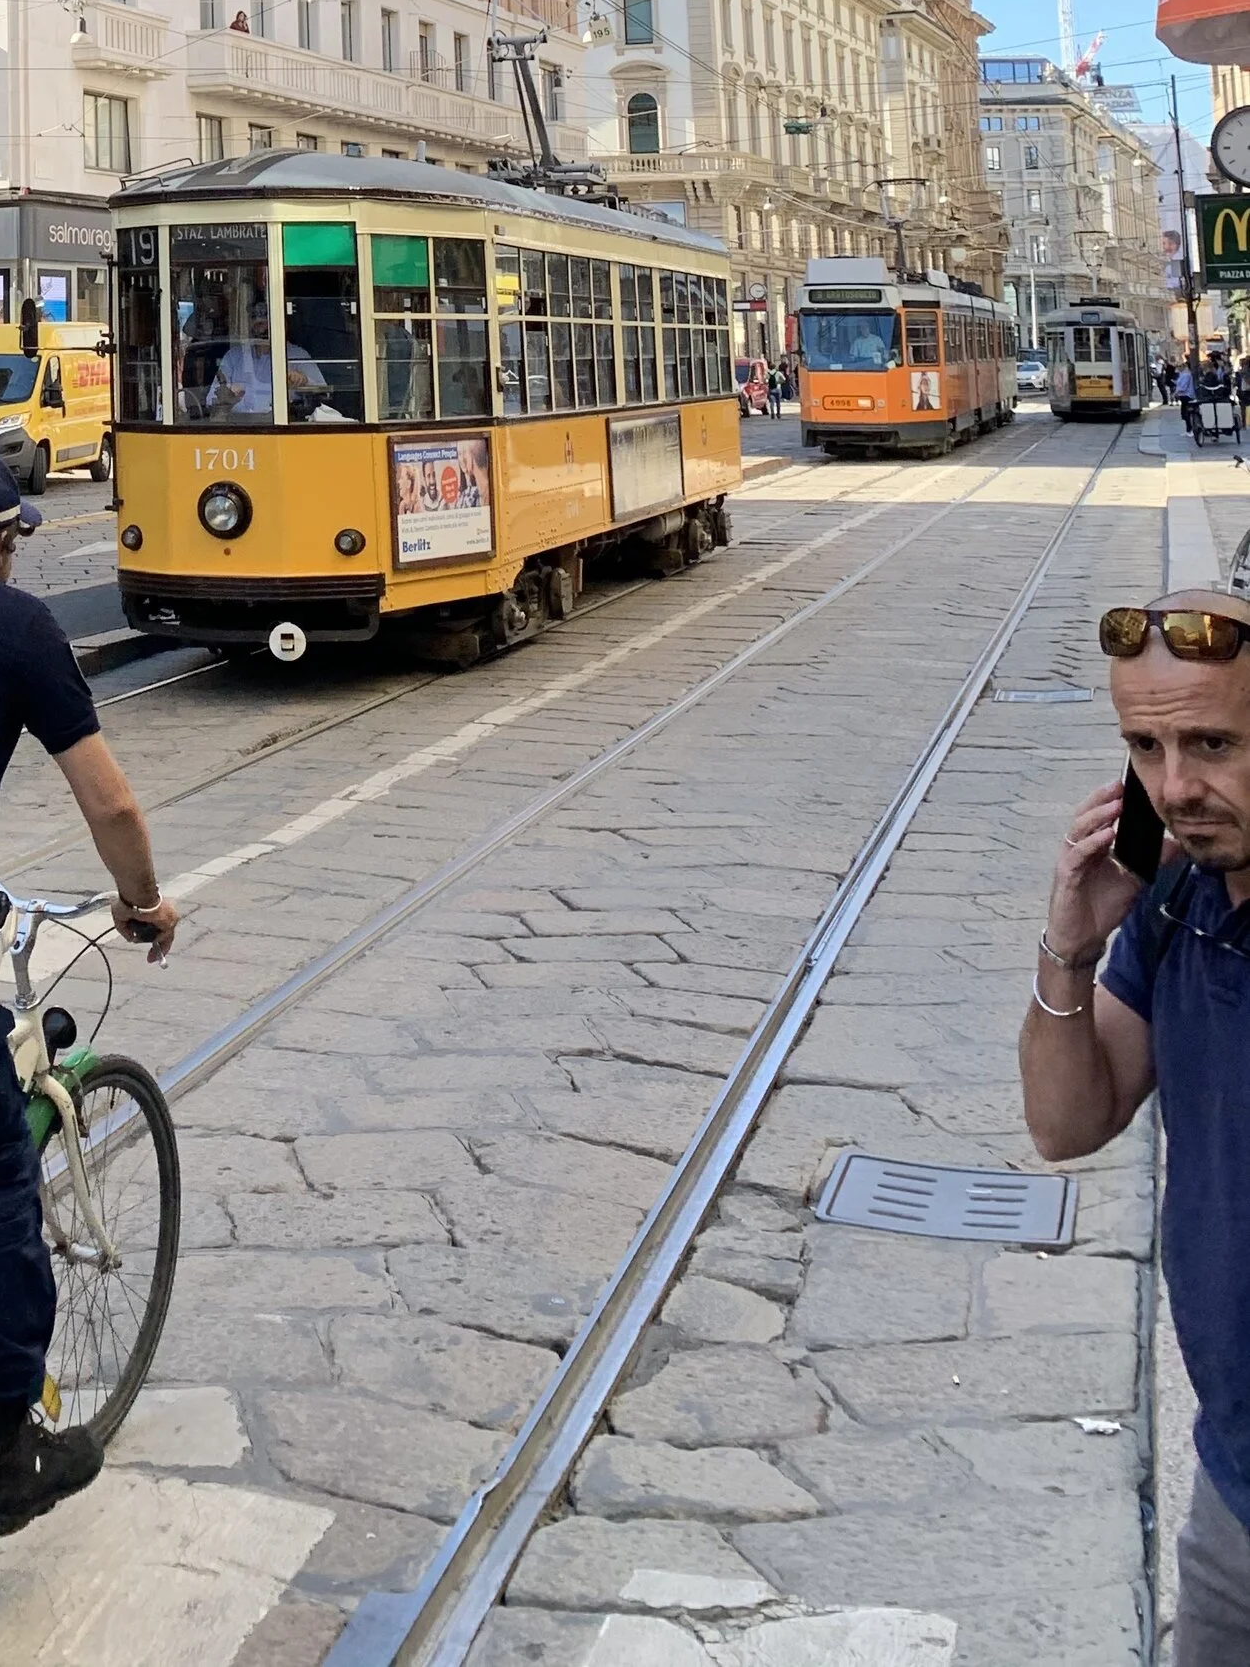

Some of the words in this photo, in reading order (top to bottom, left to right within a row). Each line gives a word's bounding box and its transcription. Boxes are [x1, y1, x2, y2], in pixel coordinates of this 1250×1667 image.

[593, 27, 610, 39] 195
[49, 221, 111, 252] salmoirag
[177, 225, 207, 240] STAZ.
[211, 223, 267, 239] LAMBRATE
[130, 228, 156, 265] 19
[1219, 270, 1244, 279] PIAZZA
[194, 448, 254, 470] 1704
[402, 538, 431, 553] Berlitz
